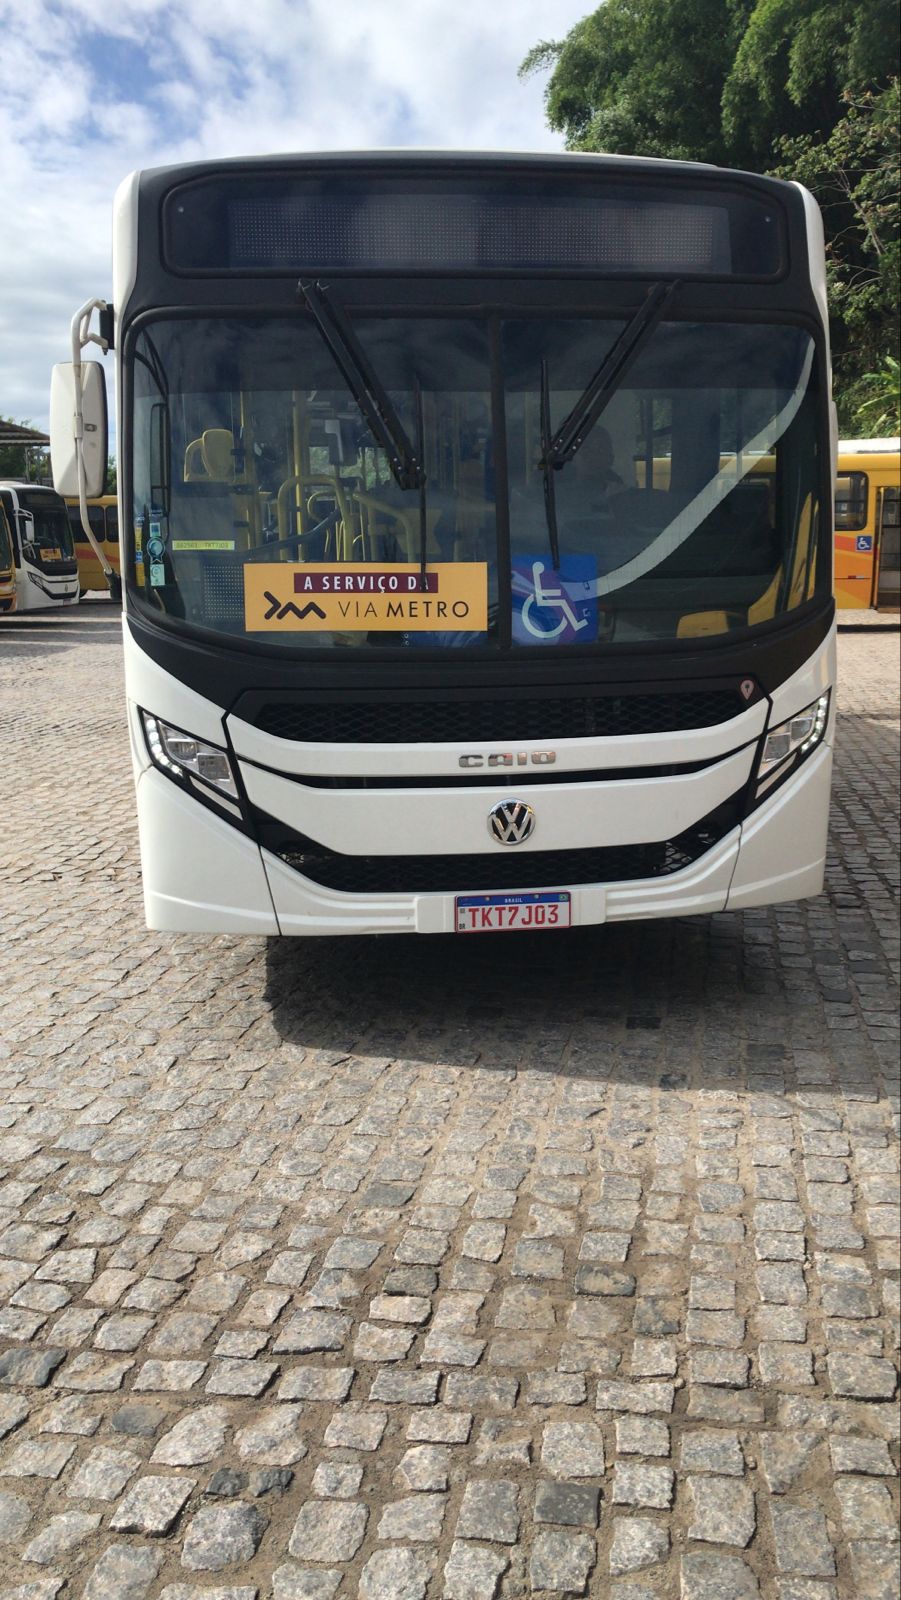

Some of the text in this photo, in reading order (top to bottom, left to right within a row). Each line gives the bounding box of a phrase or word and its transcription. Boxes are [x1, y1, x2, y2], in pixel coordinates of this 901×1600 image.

[303, 576, 313, 590] A
[322, 576, 398, 593] SERVIÇO
[338, 601, 470, 618] VIA METRO
[459, 751, 557, 768] CAIO
[468, 904, 559, 928] TKT7J03
